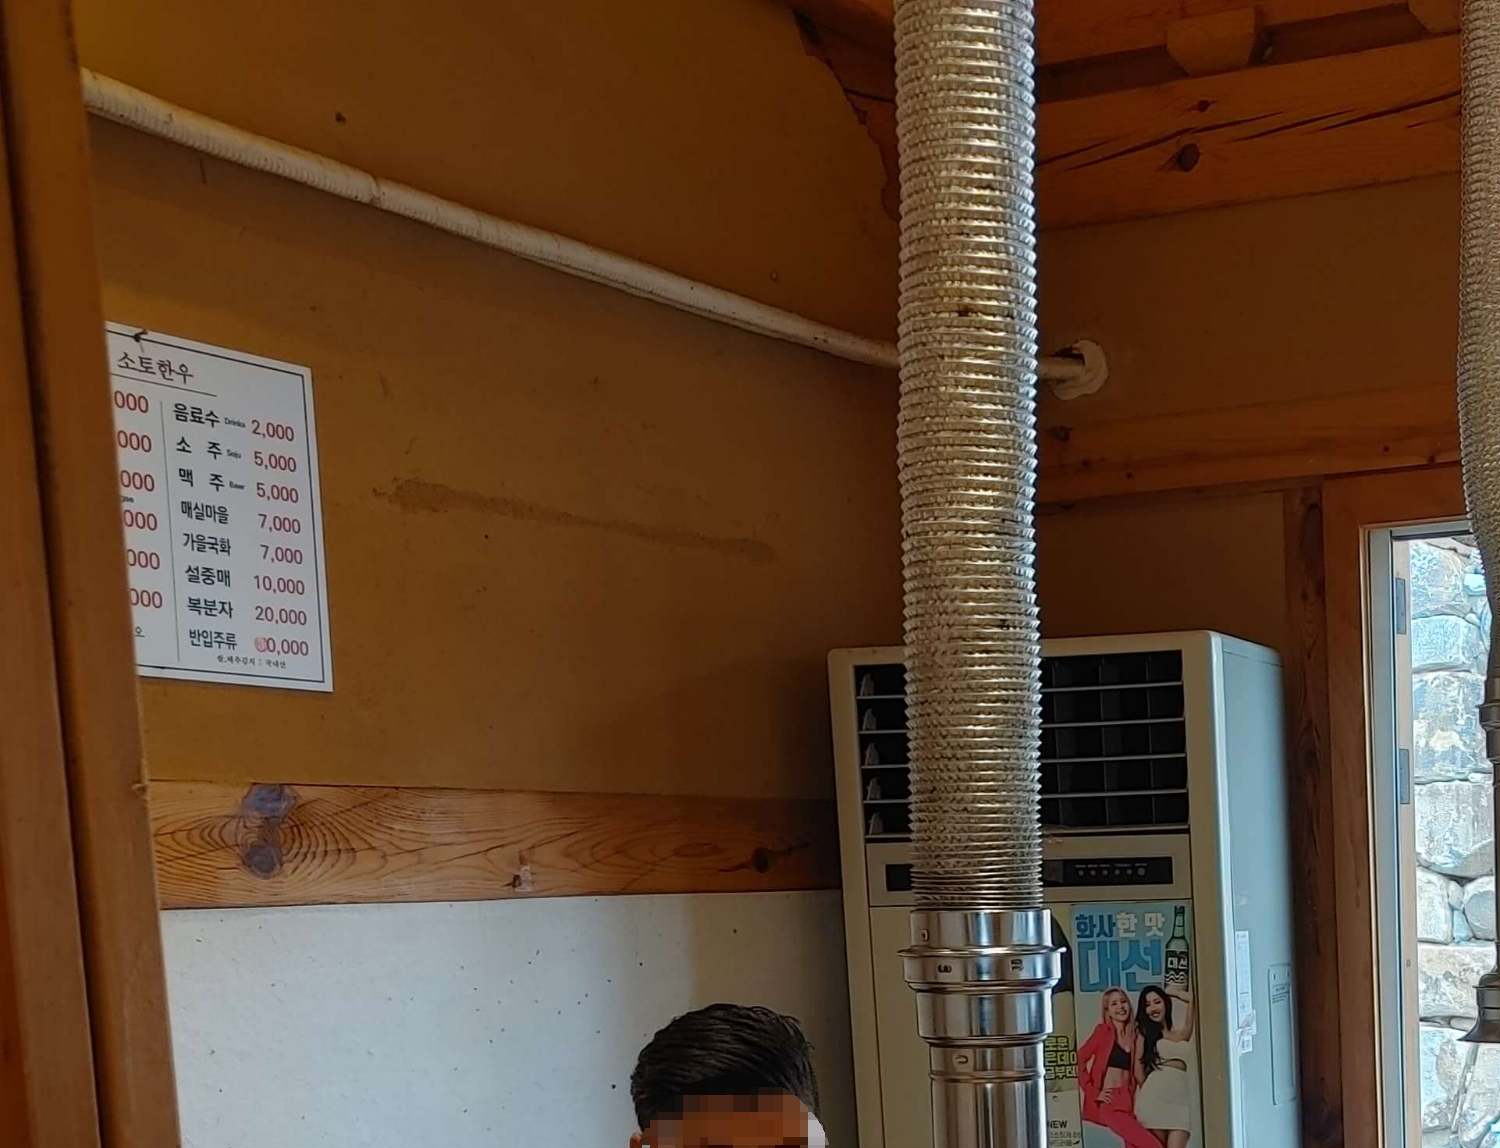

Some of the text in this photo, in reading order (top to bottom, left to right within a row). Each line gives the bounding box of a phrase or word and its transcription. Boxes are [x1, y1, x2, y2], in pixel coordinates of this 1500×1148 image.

[117, 351, 194, 385] 소토한우
[173, 402, 221, 428] 음료수
[251, 419, 294, 442] 2,000
[254, 450, 297, 473] 5,000
[256, 482, 299, 504] 5,000
[180, 500, 301, 534] 매실마을 7,000
[182, 532, 303, 565] 가을국화 7,000
[185, 564, 305, 596] 설중매 10,000
[187, 596, 307, 626] 복분자 20,000
[189, 628, 309, 657] 반입주류 0,000
[1075, 911, 1166, 939] 화사한 맛
[1077, 939, 1162, 993] 대선
